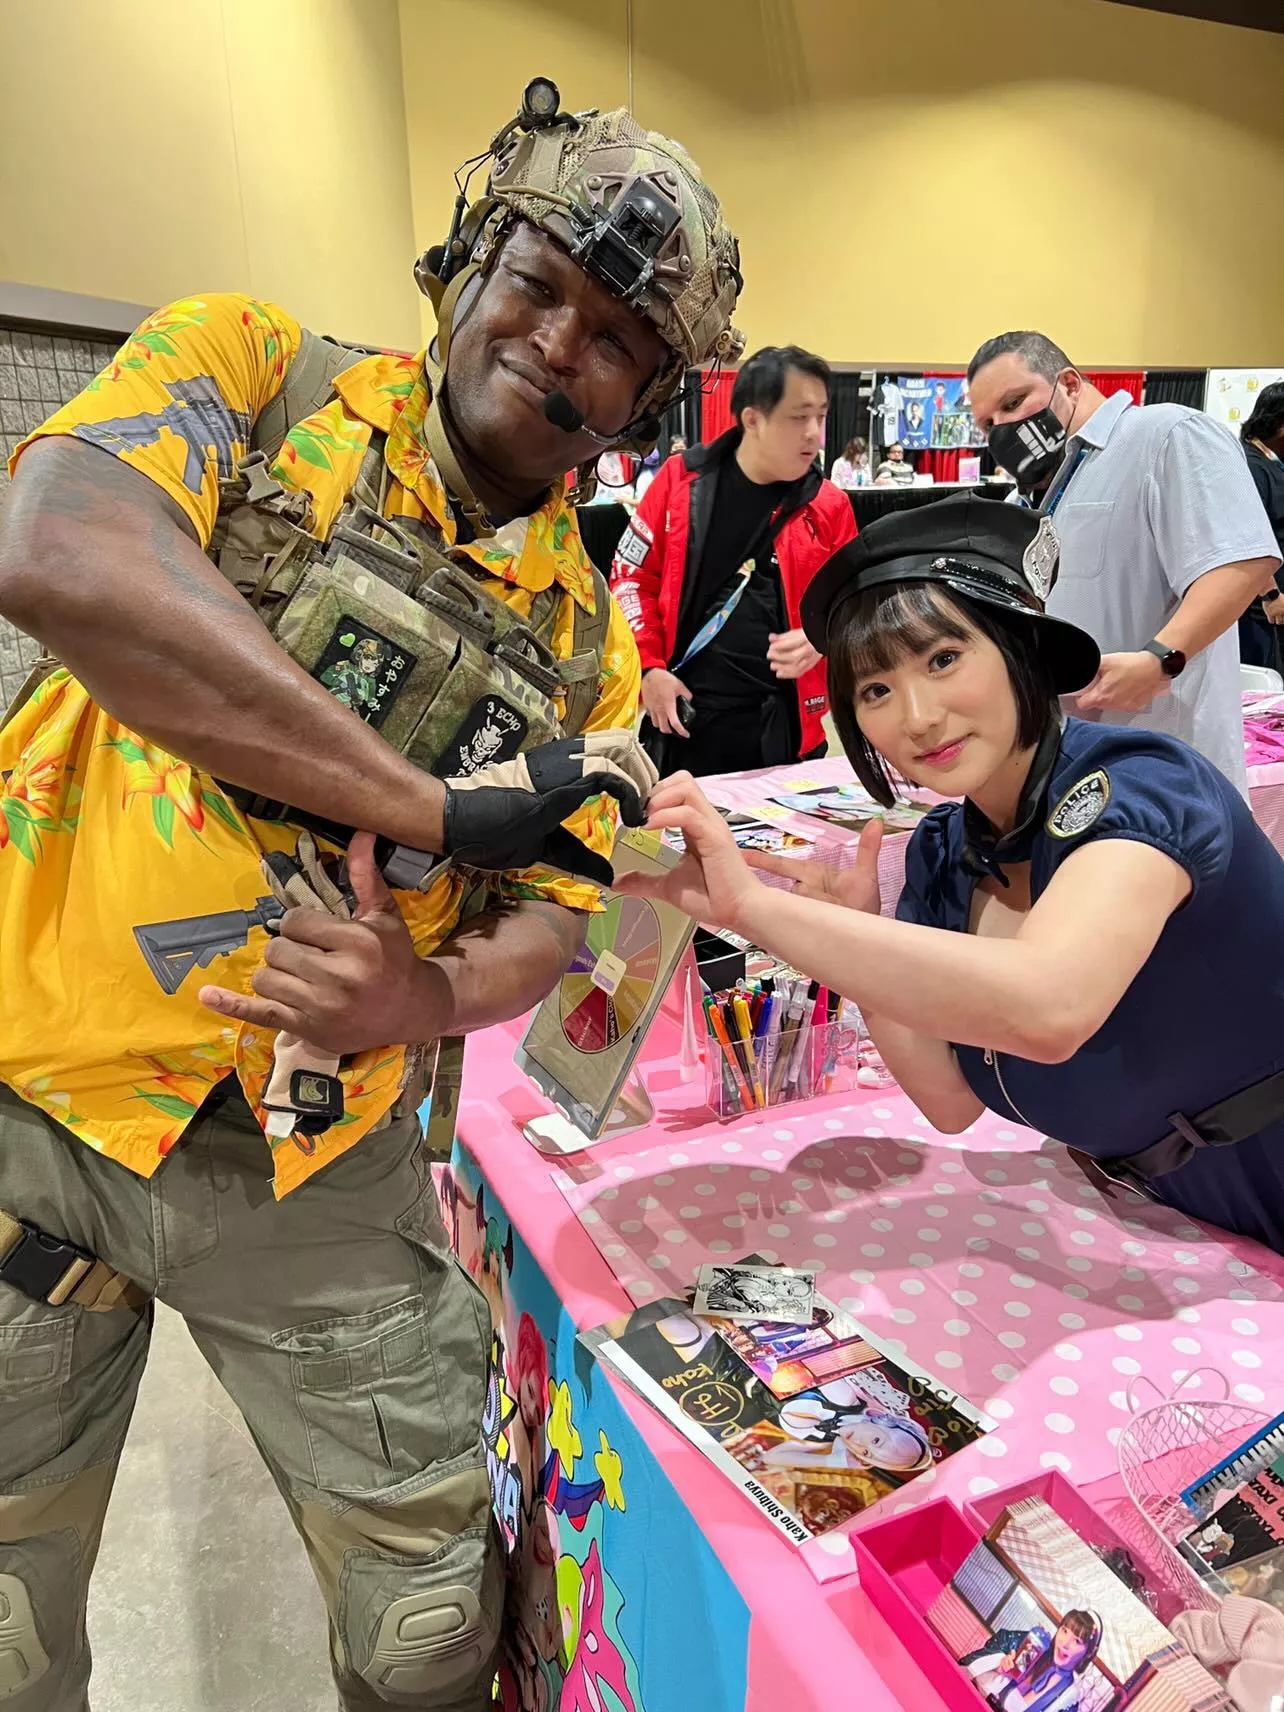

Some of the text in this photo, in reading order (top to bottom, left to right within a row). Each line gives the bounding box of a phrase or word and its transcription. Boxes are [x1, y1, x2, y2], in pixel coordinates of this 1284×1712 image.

[486, 701, 521, 731] 3 ECHO
[1054, 778, 1099, 824] POLICE
[744, 1480, 808, 1542] Kaho Shibuya
